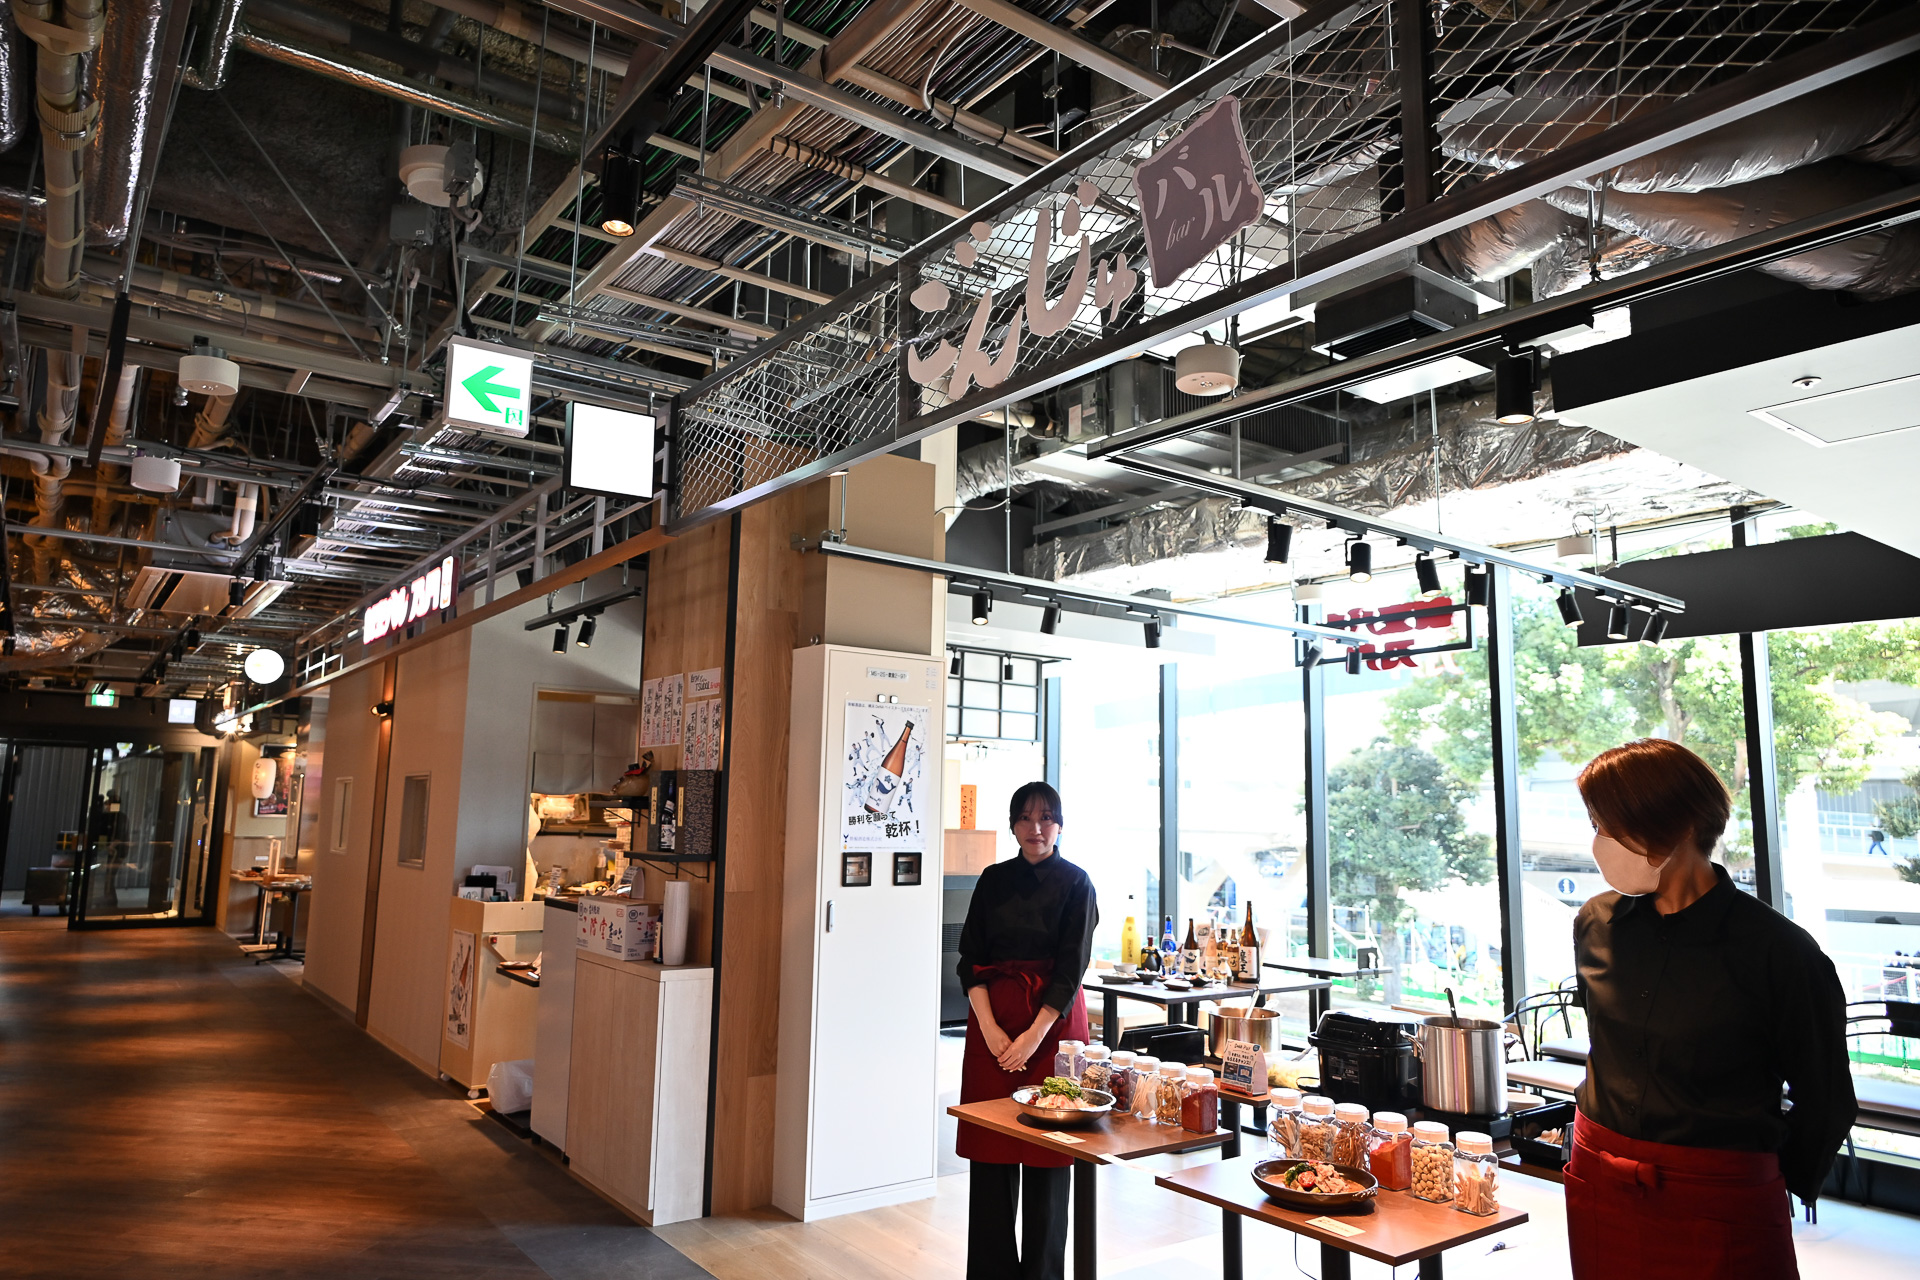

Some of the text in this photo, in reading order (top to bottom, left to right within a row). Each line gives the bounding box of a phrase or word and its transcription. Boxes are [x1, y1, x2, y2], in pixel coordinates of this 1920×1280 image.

[1155, 145, 1242, 241] バル
[1165, 215, 1197, 251] bar
[848, 810, 897, 827] 勝利を願って
[1239, 949, 1248, 974] 魔王
